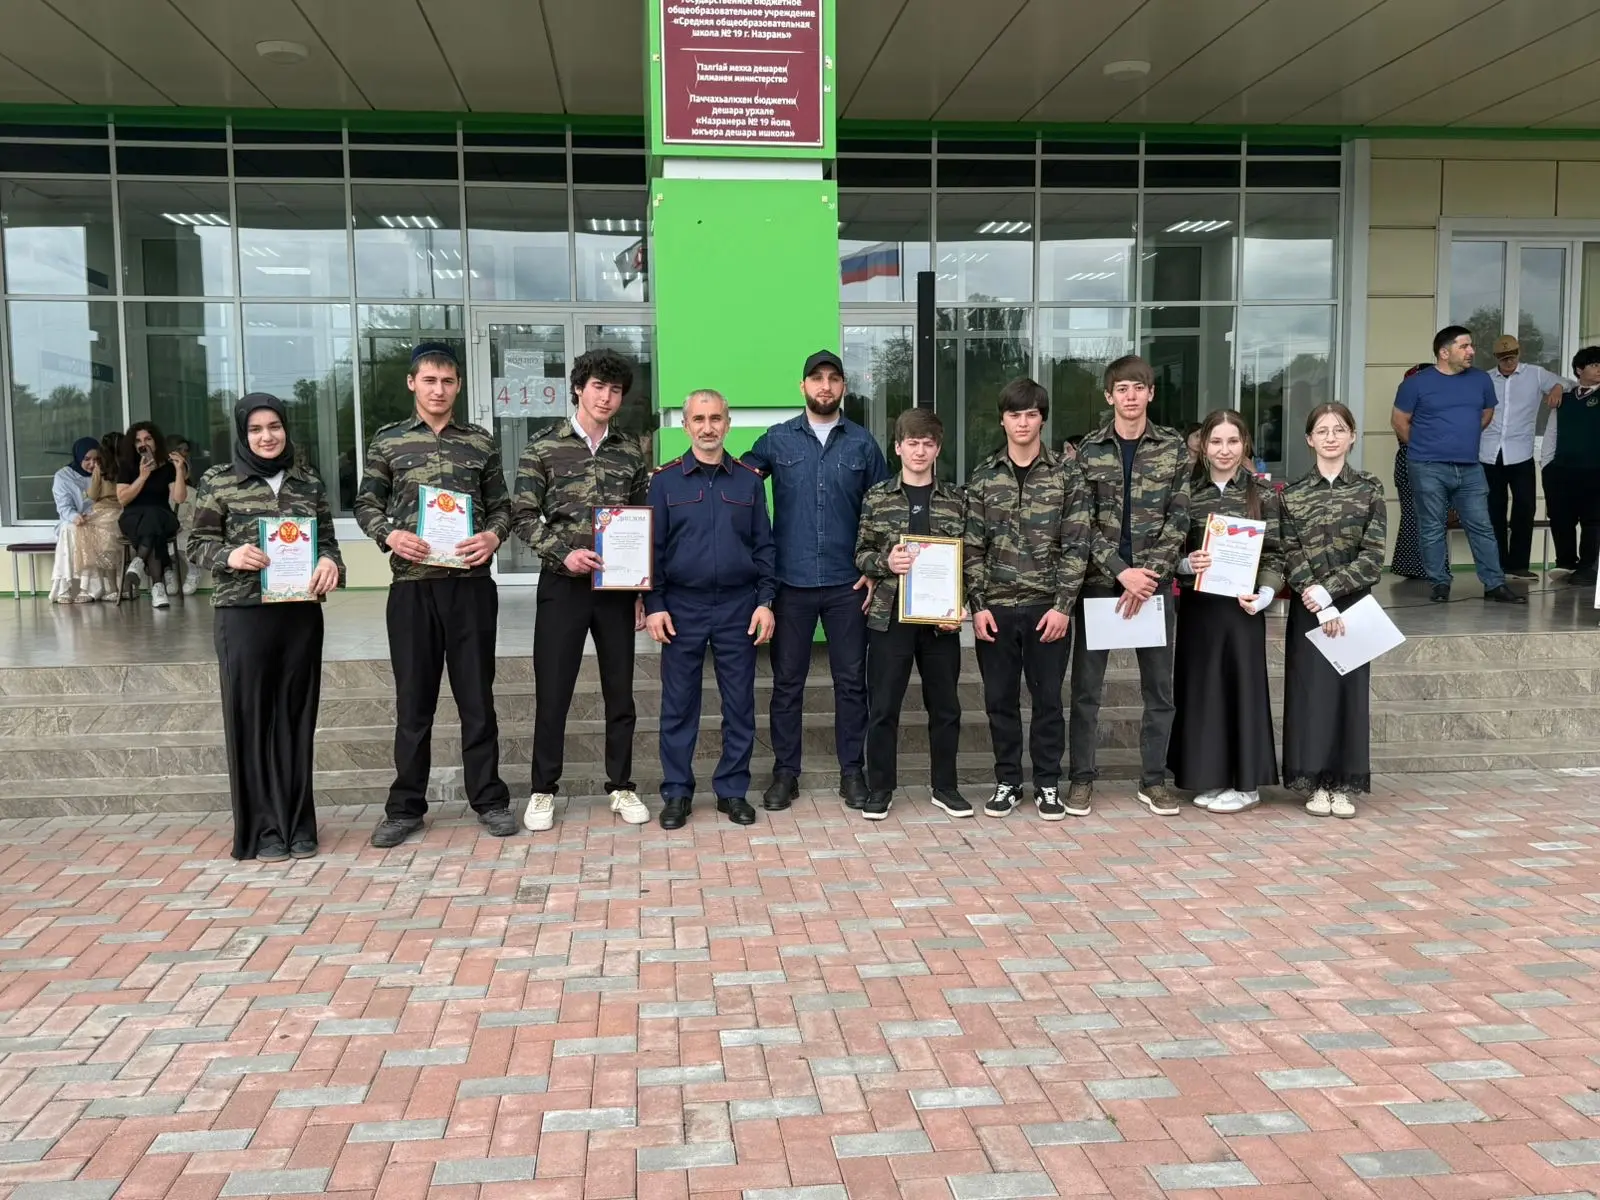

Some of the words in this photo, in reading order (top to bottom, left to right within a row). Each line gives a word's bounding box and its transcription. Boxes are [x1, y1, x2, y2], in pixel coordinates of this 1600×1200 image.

[667, 7, 763, 17] общеобразовательное
[764, 9, 816, 18] учреждение
[716, 18, 811, 28] общеобразовательная
[692, 29, 719, 37] школа
[721, 29, 731, 37] №
[733, 29, 743, 38] 19
[734, 75, 788, 84] министерство
[711, 107, 744, 116] дешара
[748, 117, 758, 126] №
[760, 118, 769, 126] 19
[771, 117, 791, 127] йола
[725, 129, 757, 138] дешара
